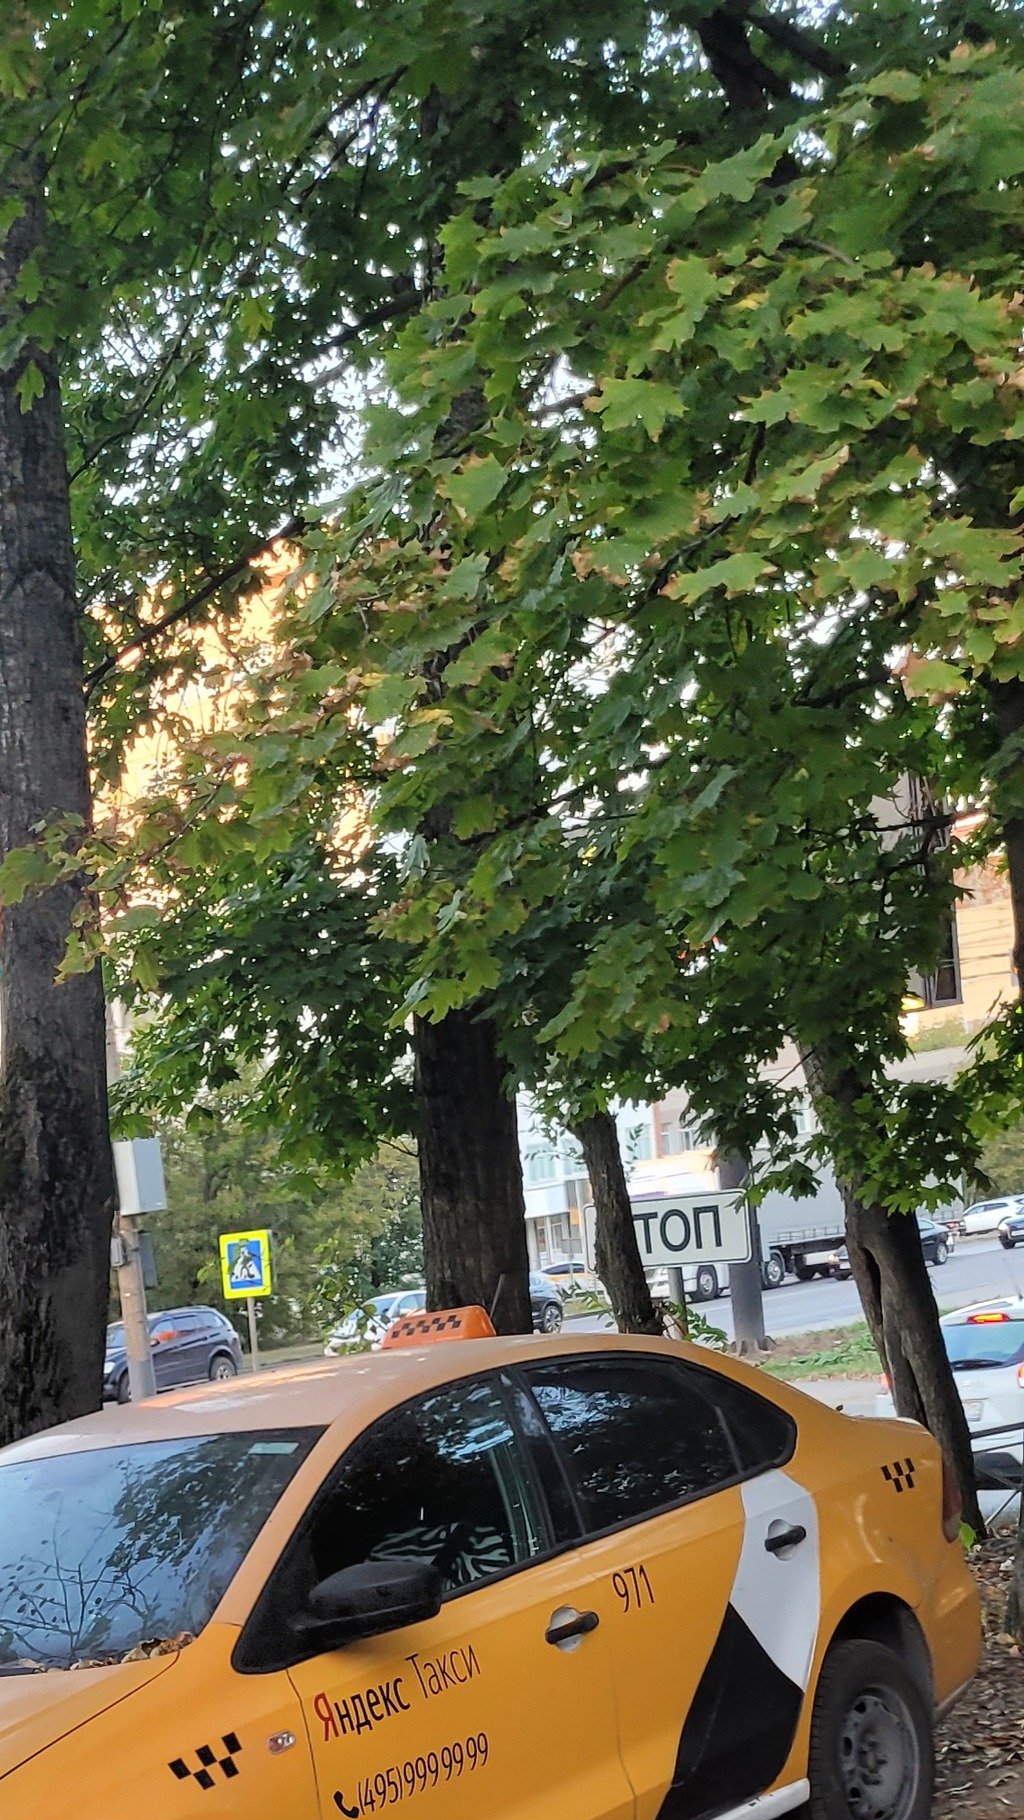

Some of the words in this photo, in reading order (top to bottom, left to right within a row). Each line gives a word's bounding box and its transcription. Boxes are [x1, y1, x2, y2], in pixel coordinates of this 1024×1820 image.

[633, 1205, 723, 1254] ТОП
[612, 1564, 655, 1613] 971
[314, 1677, 411, 1742] Яндекс
[405, 1644, 481, 1699] Такси
